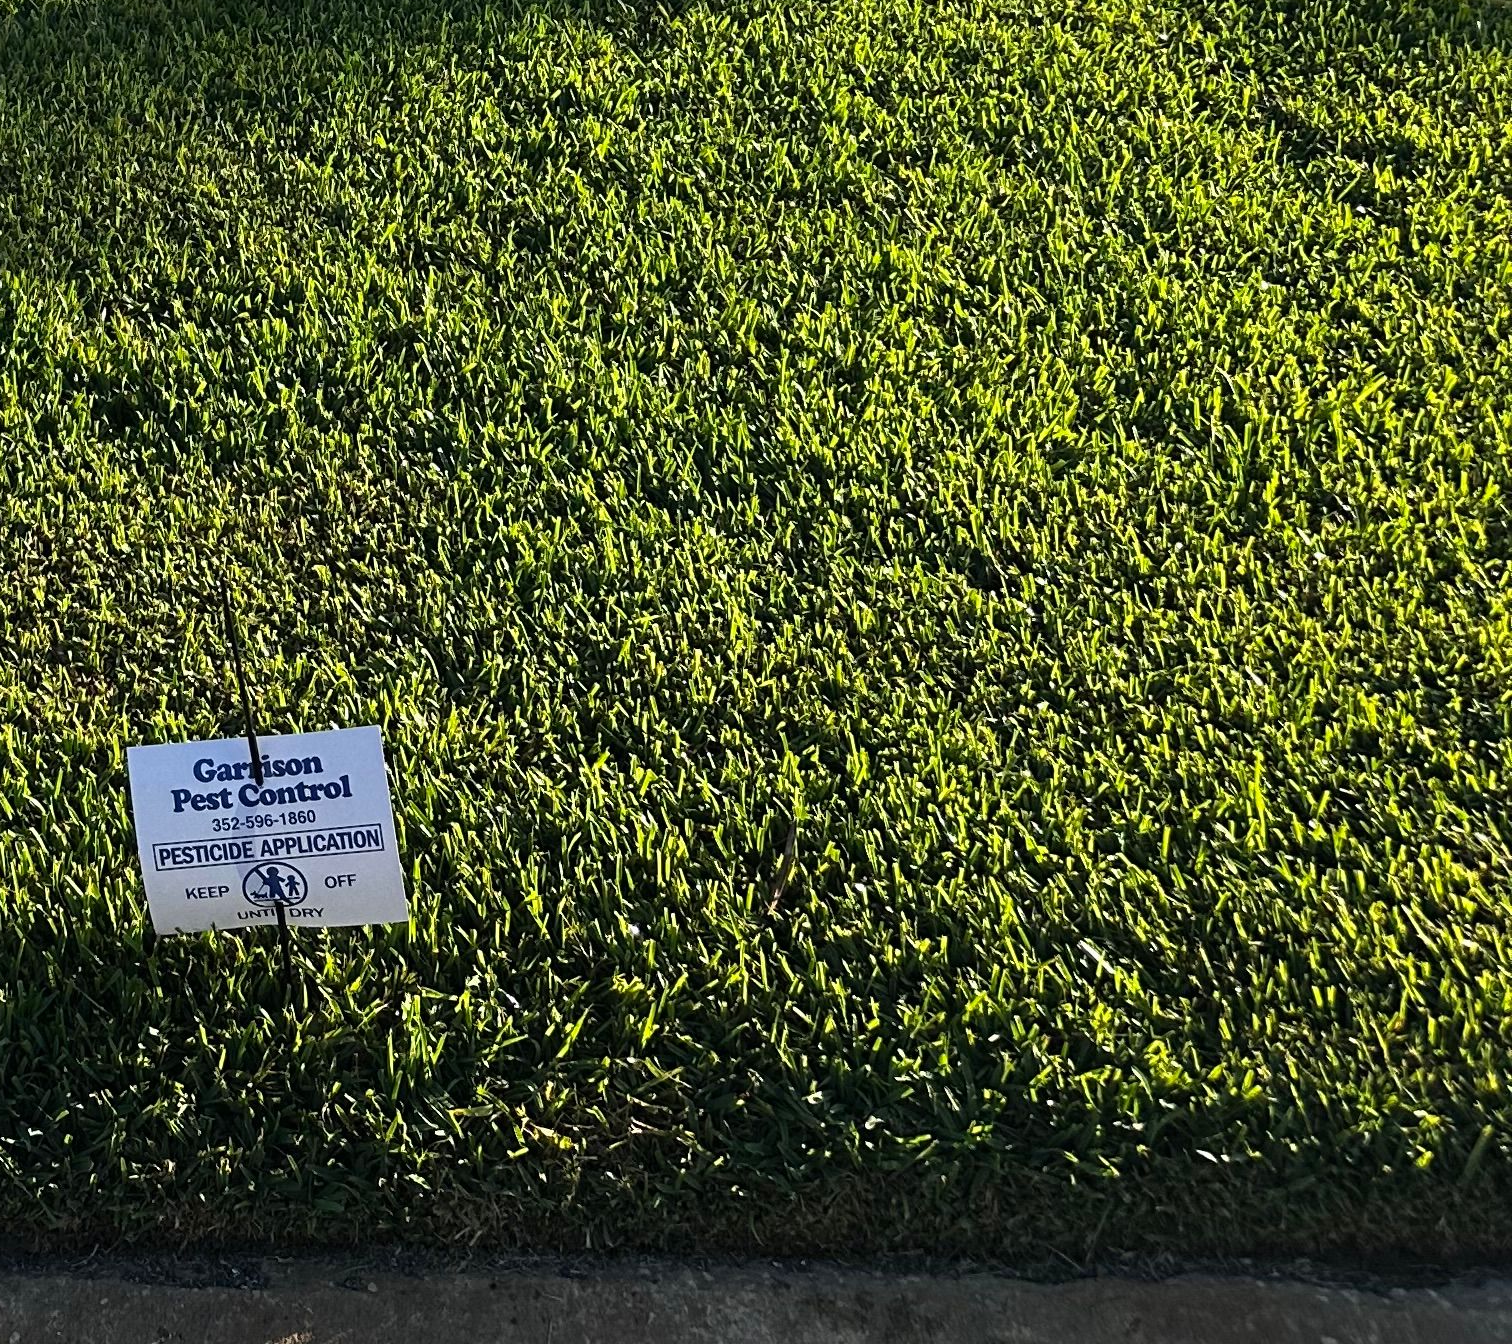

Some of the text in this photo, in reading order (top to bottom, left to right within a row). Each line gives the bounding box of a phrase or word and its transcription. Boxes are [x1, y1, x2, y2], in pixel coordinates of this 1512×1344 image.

[171, 775, 352, 812] Pest Control
[212, 810, 316, 832] 352-596-1860
[159, 829, 380, 866] PESTICIDE APPLICATION
[185, 874, 357, 900] KEEP OFF
[237, 907, 325, 920] UNTI DRY
